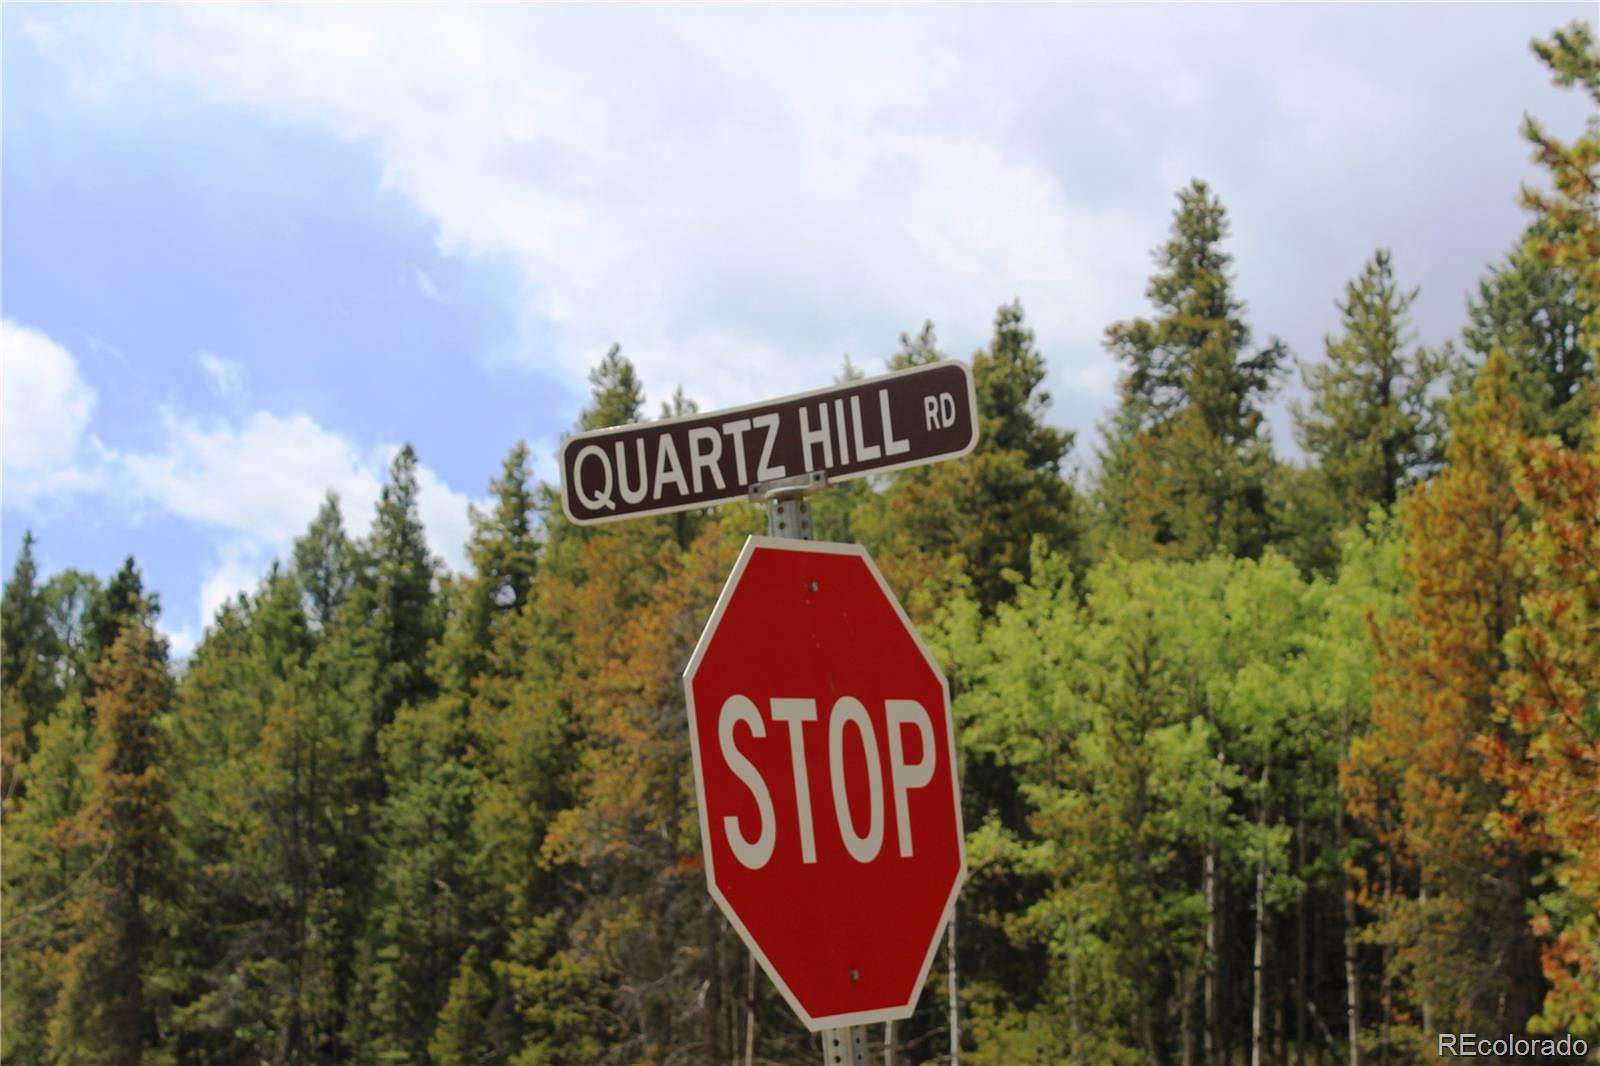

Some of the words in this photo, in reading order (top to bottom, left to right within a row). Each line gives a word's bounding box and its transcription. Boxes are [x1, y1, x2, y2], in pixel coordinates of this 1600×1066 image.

[573, 413, 787, 511] QUARTZ
[799, 389, 910, 473] HILL
[923, 392, 956, 432] RD
[718, 694, 937, 870] STOP
